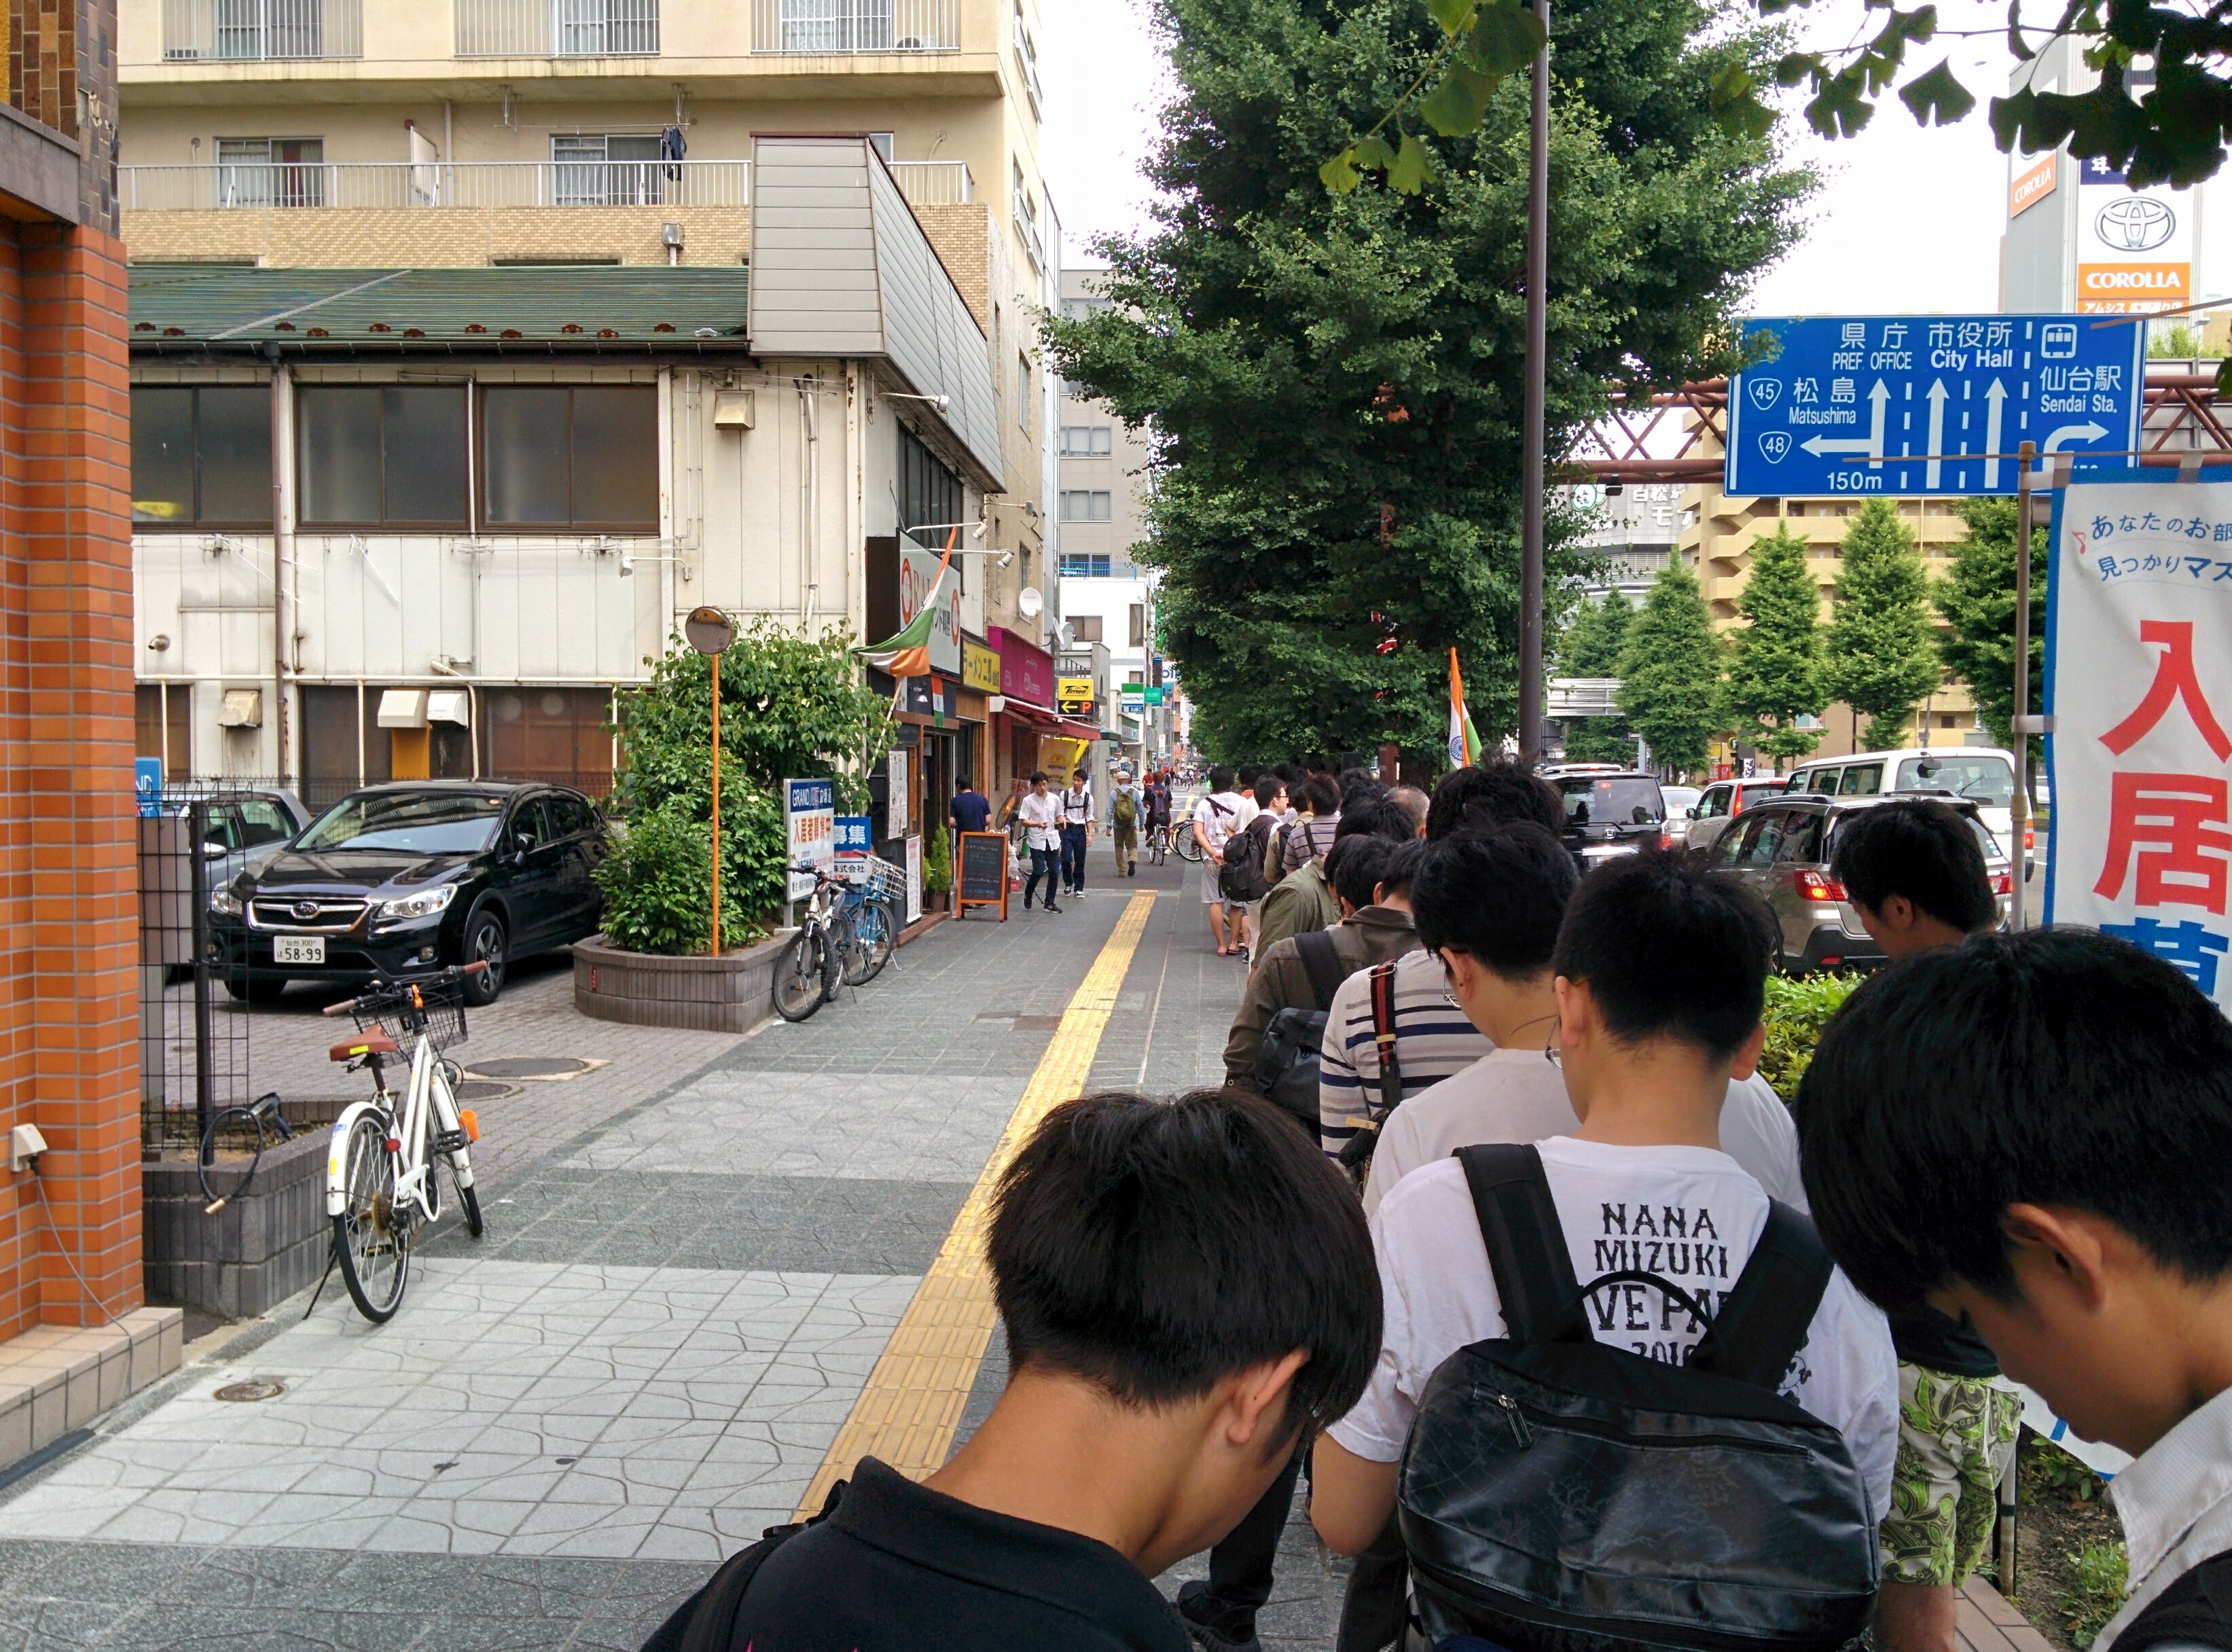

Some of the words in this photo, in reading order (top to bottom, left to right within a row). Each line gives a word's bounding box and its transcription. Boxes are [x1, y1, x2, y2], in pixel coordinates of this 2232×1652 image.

[2015, 167, 2051, 203] COROLLA
[2087, 272, 2180, 288] COROLLA
[1928, 321, 2013, 348] 市役所
[1870, 351, 1912, 370] OFFICE
[1931, 350, 1967, 371] City
[1976, 348, 2013, 368] Hall
[2040, 365, 2121, 392] 仙台駅
[1756, 382, 1774, 399] 45
[1793, 376, 1856, 405] 松島
[2040, 394, 2087, 413] Sendai
[2091, 395, 2117, 413] Sta.
[1788, 407, 1856, 425] Matsushima
[1765, 436, 1784, 454] 48
[1827, 472, 1882, 490] 150m
[1065, 685, 1089, 694] Times
[1082, 702, 1092, 713] P
[285, 948, 321, 960] 58-99
[1601, 1203, 1718, 1240] NANA
[1594, 1240, 1729, 1278] MIZUKI
